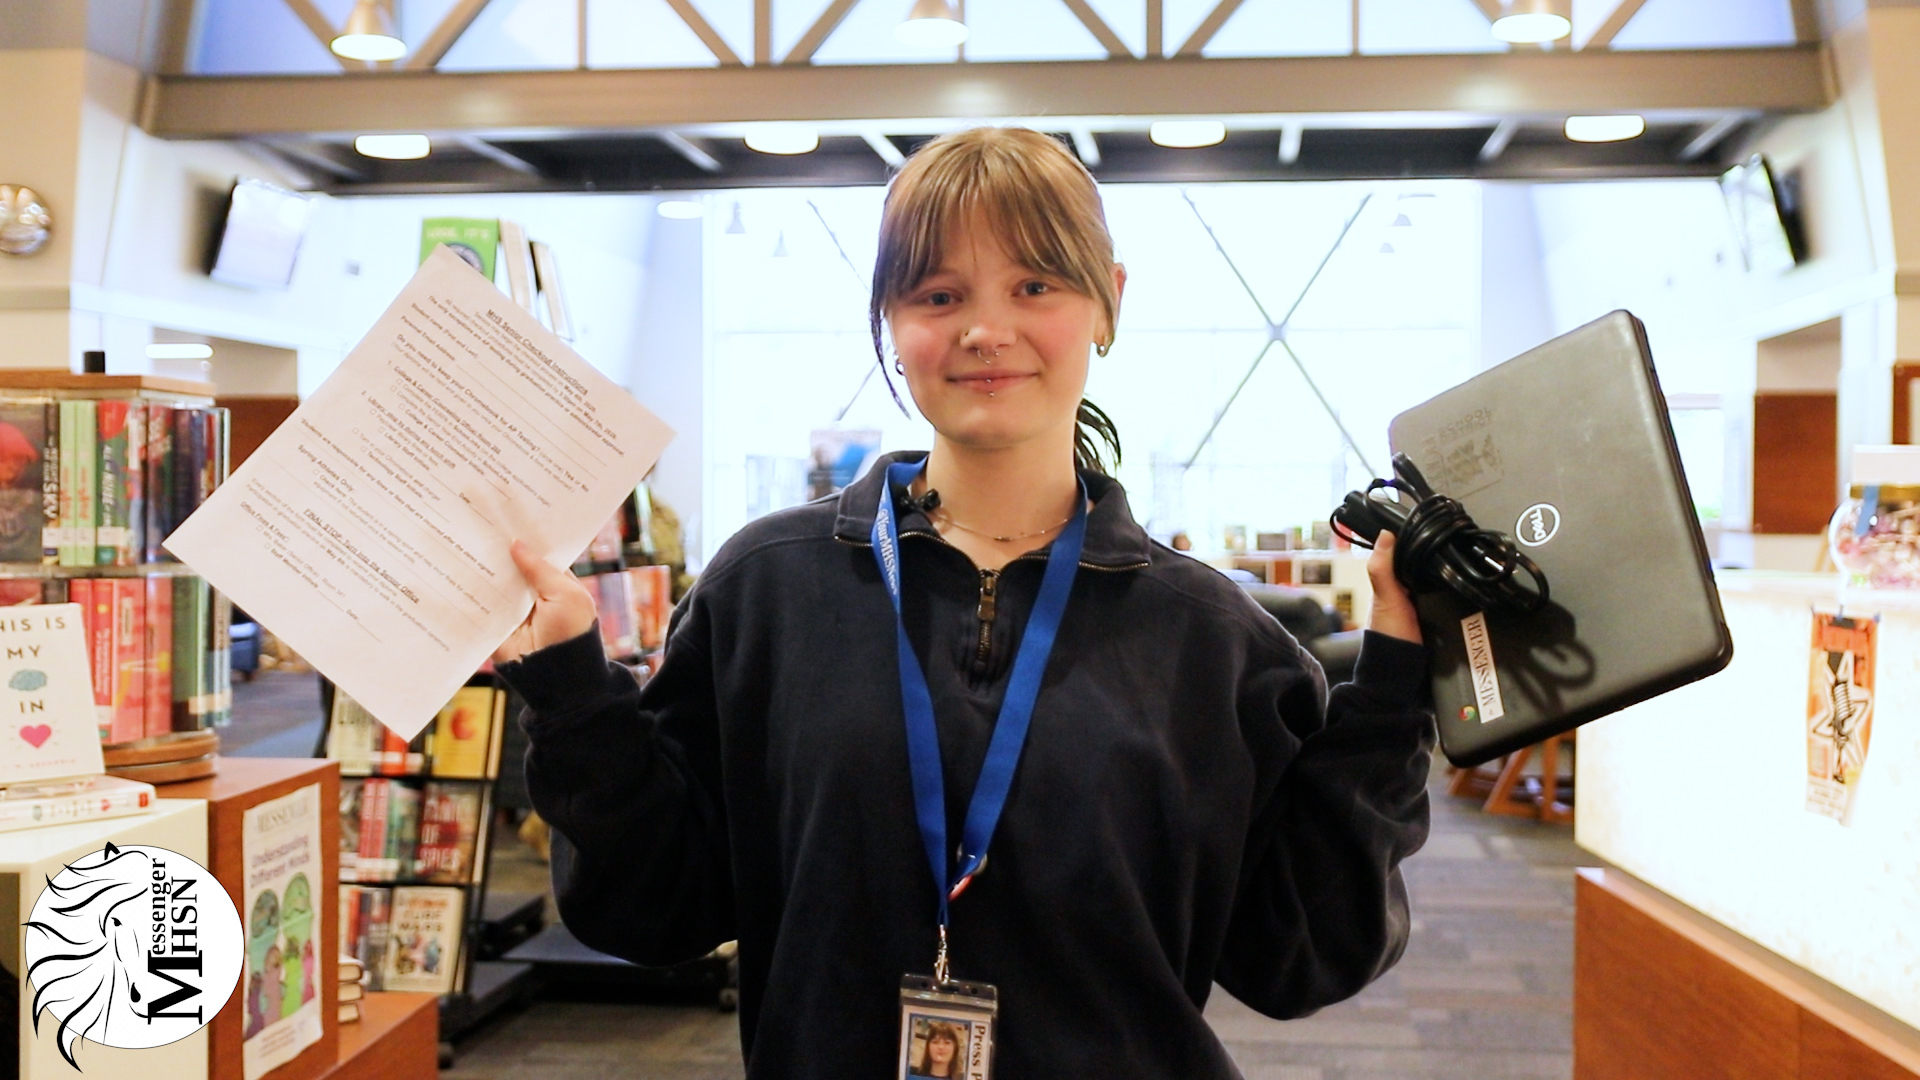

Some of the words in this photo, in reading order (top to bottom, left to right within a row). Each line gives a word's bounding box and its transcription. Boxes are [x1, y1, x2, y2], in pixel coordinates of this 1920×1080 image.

[485, 308, 503, 324] MHS
[500, 320, 524, 341] Senior
[520, 337, 553, 365] Checkout
[550, 361, 590, 395] Instructions
[295, 443, 318, 463] Spring
[315, 458, 342, 481] Athletes
[43, 482, 58, 519] SKY
[44, 616, 66, 630] IS
[7, 645, 41, 659] MY
[1467, 619, 1496, 706] MESSENGER
[20, 699, 44, 714] IN
[972, 1025, 986, 1067] Press
